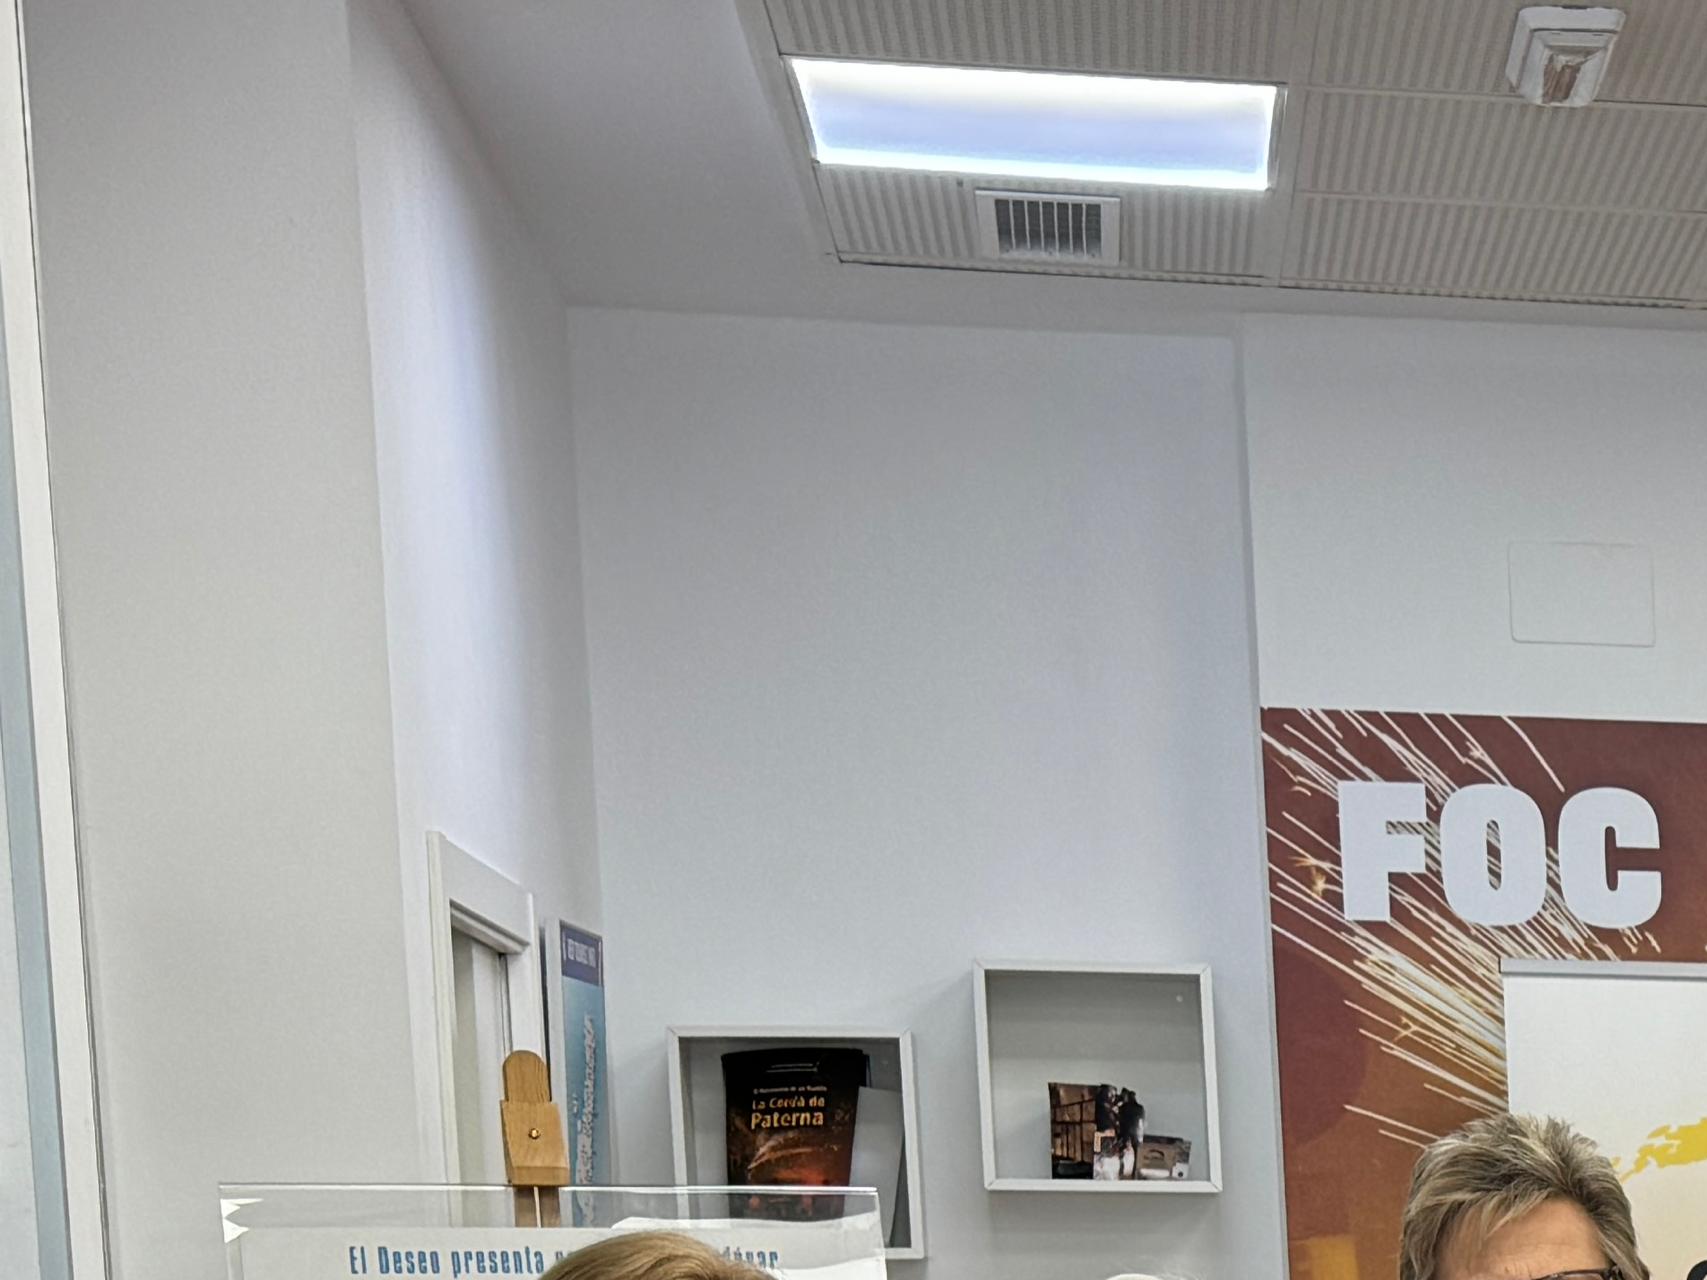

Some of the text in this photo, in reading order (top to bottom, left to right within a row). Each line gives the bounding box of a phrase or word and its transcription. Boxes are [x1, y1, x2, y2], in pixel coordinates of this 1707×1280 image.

[1338, 780, 1662, 929] FOC
[751, 1112, 824, 1130] Paterna
[349, 1246, 367, 1274] El
[378, 1246, 440, 1274] Deseo
[451, 1246, 544, 1278] presenta
